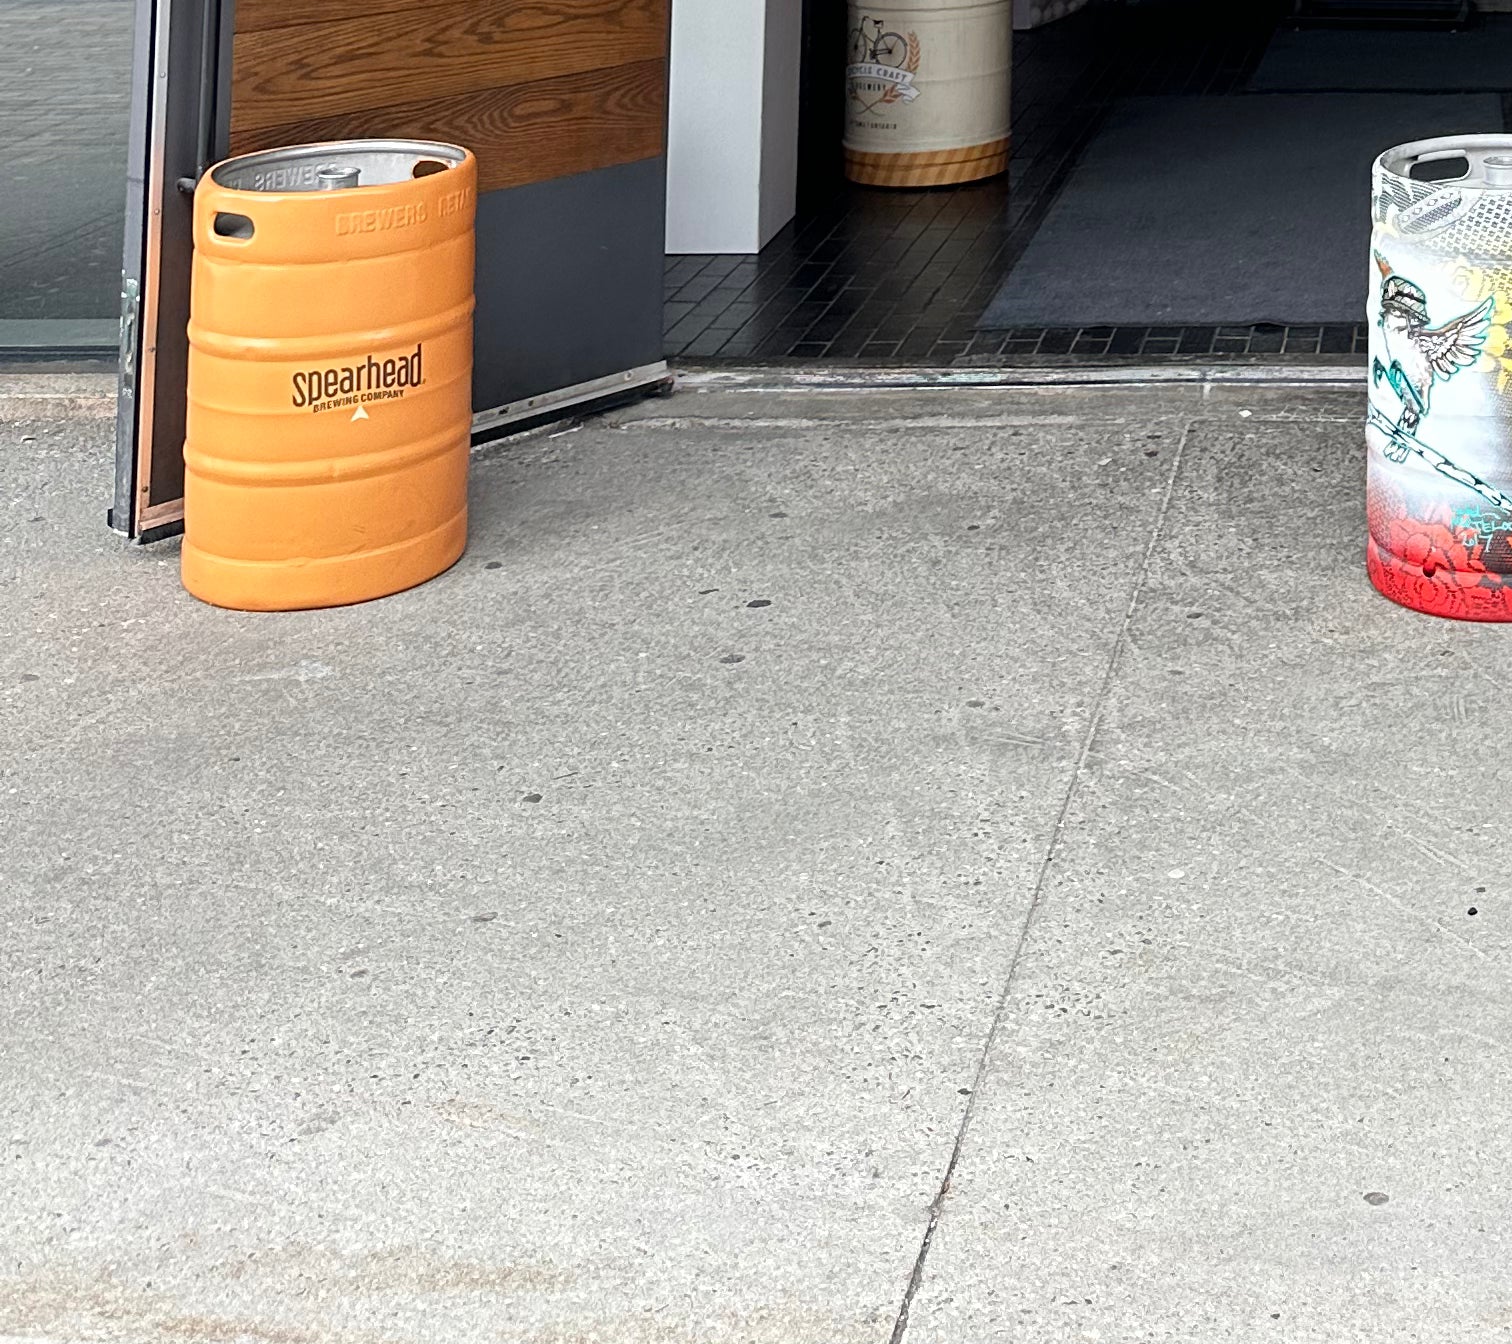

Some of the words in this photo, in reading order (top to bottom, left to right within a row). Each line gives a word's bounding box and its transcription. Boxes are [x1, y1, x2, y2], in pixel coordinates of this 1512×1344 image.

[336, 202, 428, 236] BREWERS
[292, 343, 423, 408] Spearhead
[312, 395, 359, 413] BREWING
[360, 389, 405, 403] COMPANY
